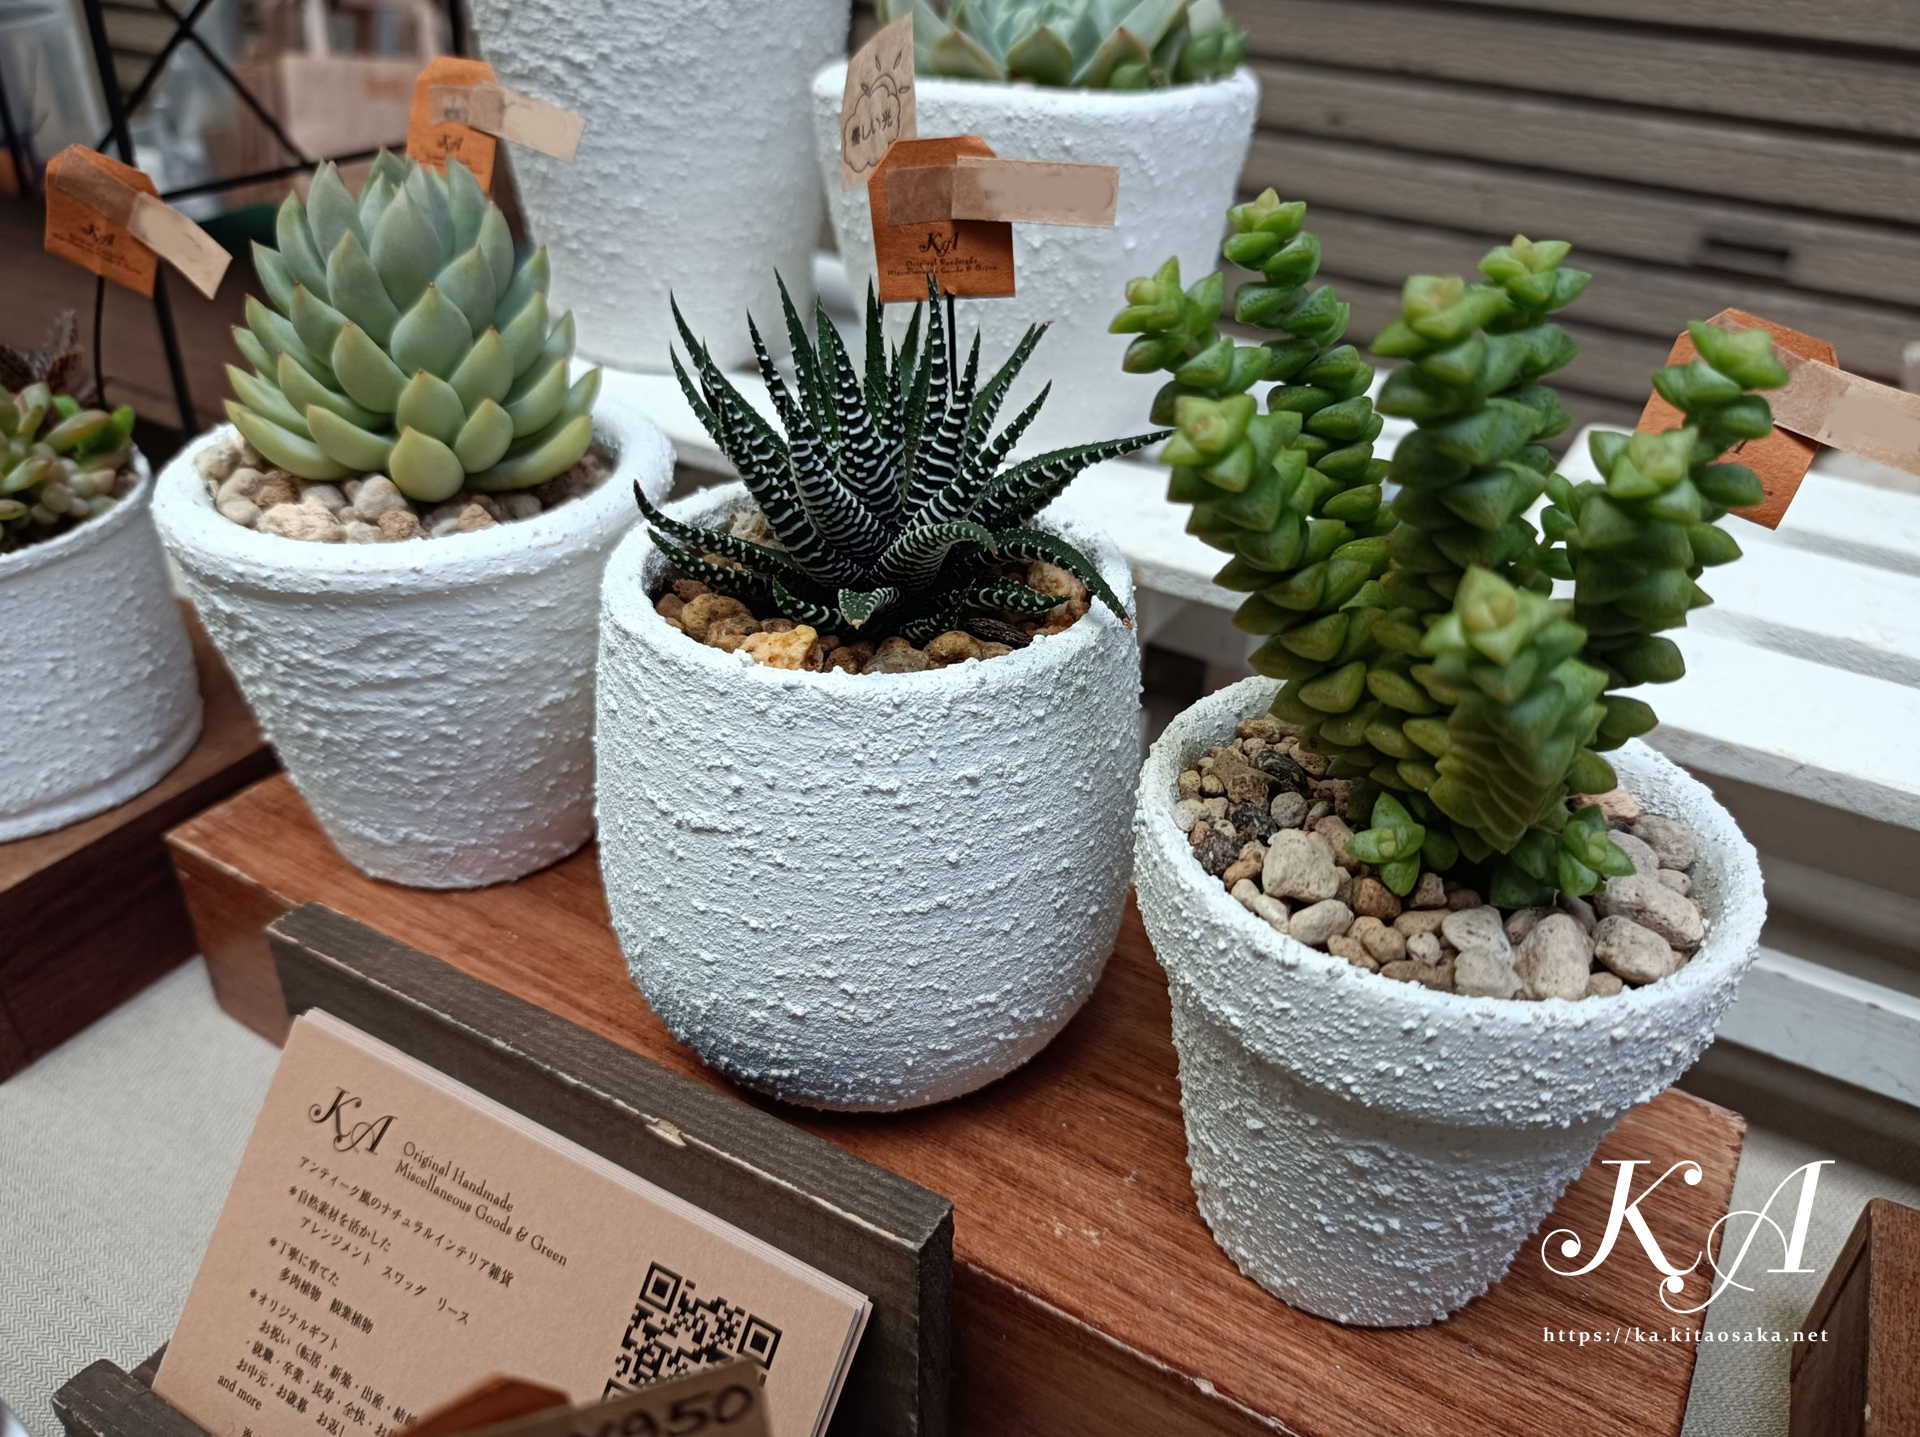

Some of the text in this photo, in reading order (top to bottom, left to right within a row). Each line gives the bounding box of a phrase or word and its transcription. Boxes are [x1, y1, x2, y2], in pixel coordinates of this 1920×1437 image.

[851, 109, 893, 147] しい光
[919, 231, 960, 257] KA
[309, 1086, 398, 1155] KA
[403, 1141, 514, 1213] Original Handmade
[300, 1156, 515, 1288] アンティーク風のナチュラルインテリア雑貨
[395, 1160, 568, 1266] Miscellaneous Goods & Green
[278, 1266, 375, 1335] 多肉植物 観葉植物
[300, 1215, 470, 1326] アレンジメント スワッグ リース
[217, 1374, 263, 1411] and more
